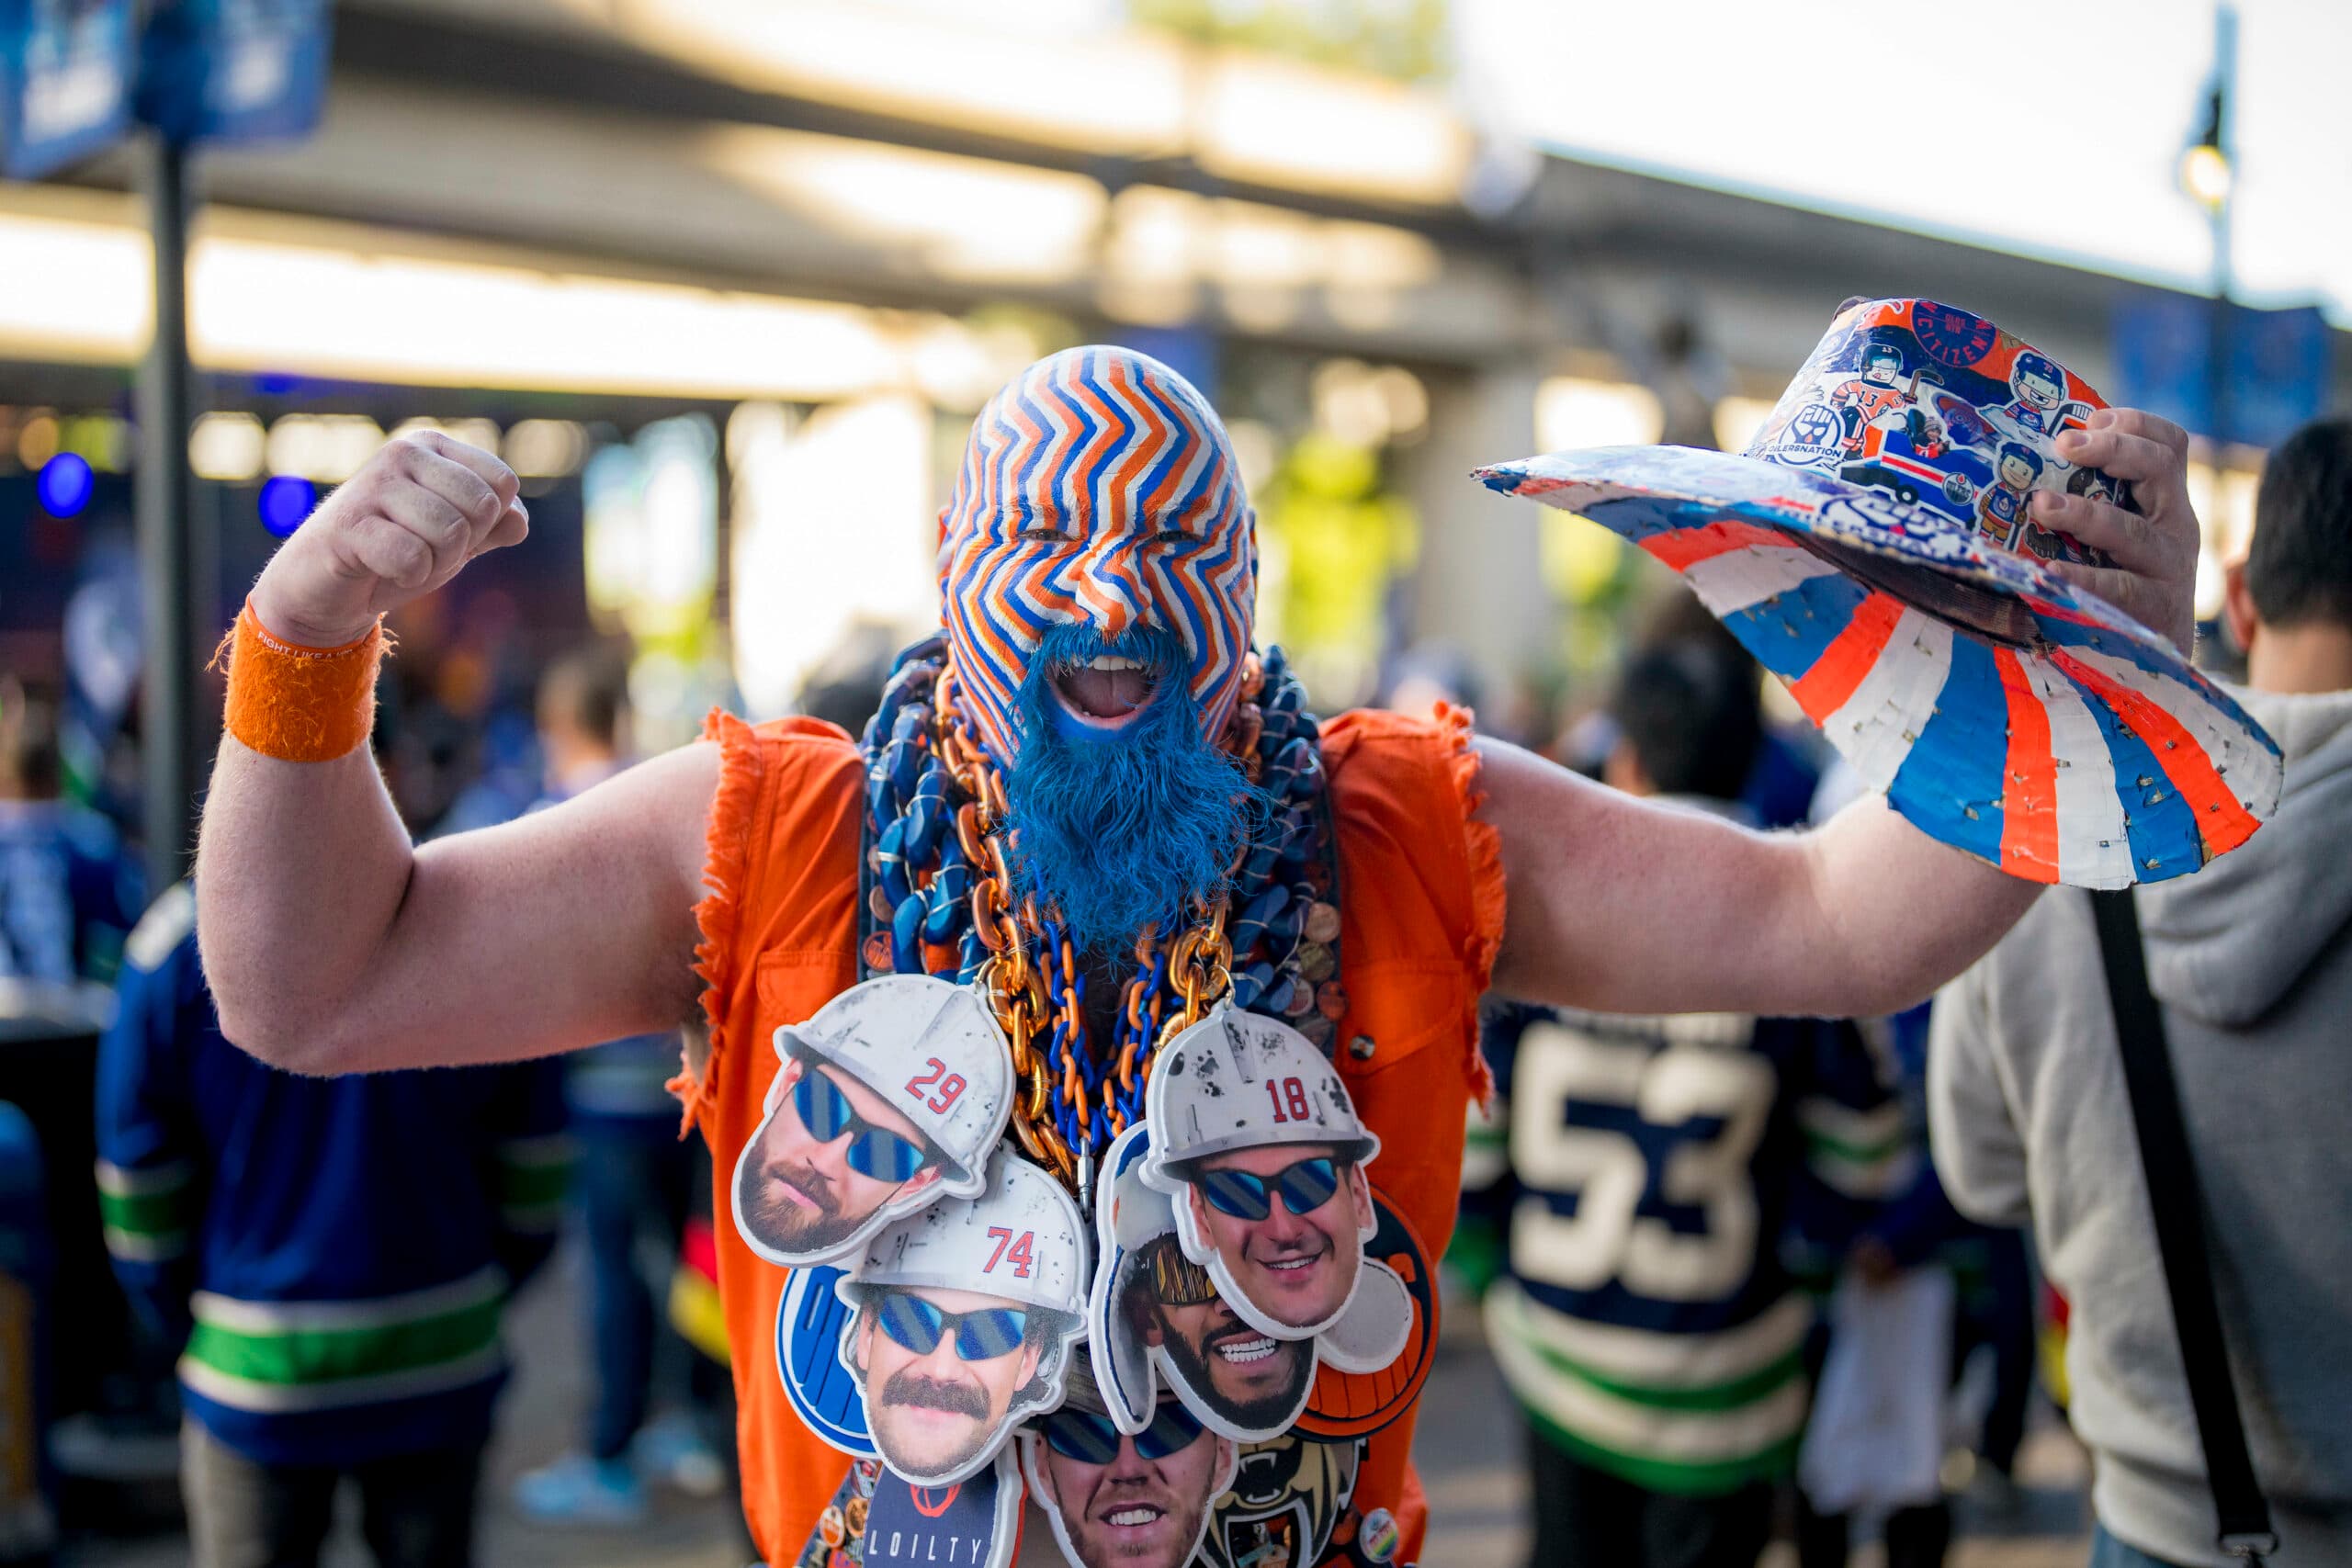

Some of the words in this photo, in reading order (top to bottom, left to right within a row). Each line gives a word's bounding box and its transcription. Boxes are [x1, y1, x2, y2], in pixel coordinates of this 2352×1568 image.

[1917, 317, 1988, 365] CITIZEN
[1859, 390, 1879, 408] 13
[257, 631, 291, 655] FIGHT
[904, 1056, 968, 1116] 29
[1265, 1077, 1311, 1124] 18
[1510, 1018, 1780, 1304] 53
[982, 1225, 1035, 1279] 74
[868, 1529, 982, 1564] LOILTY
